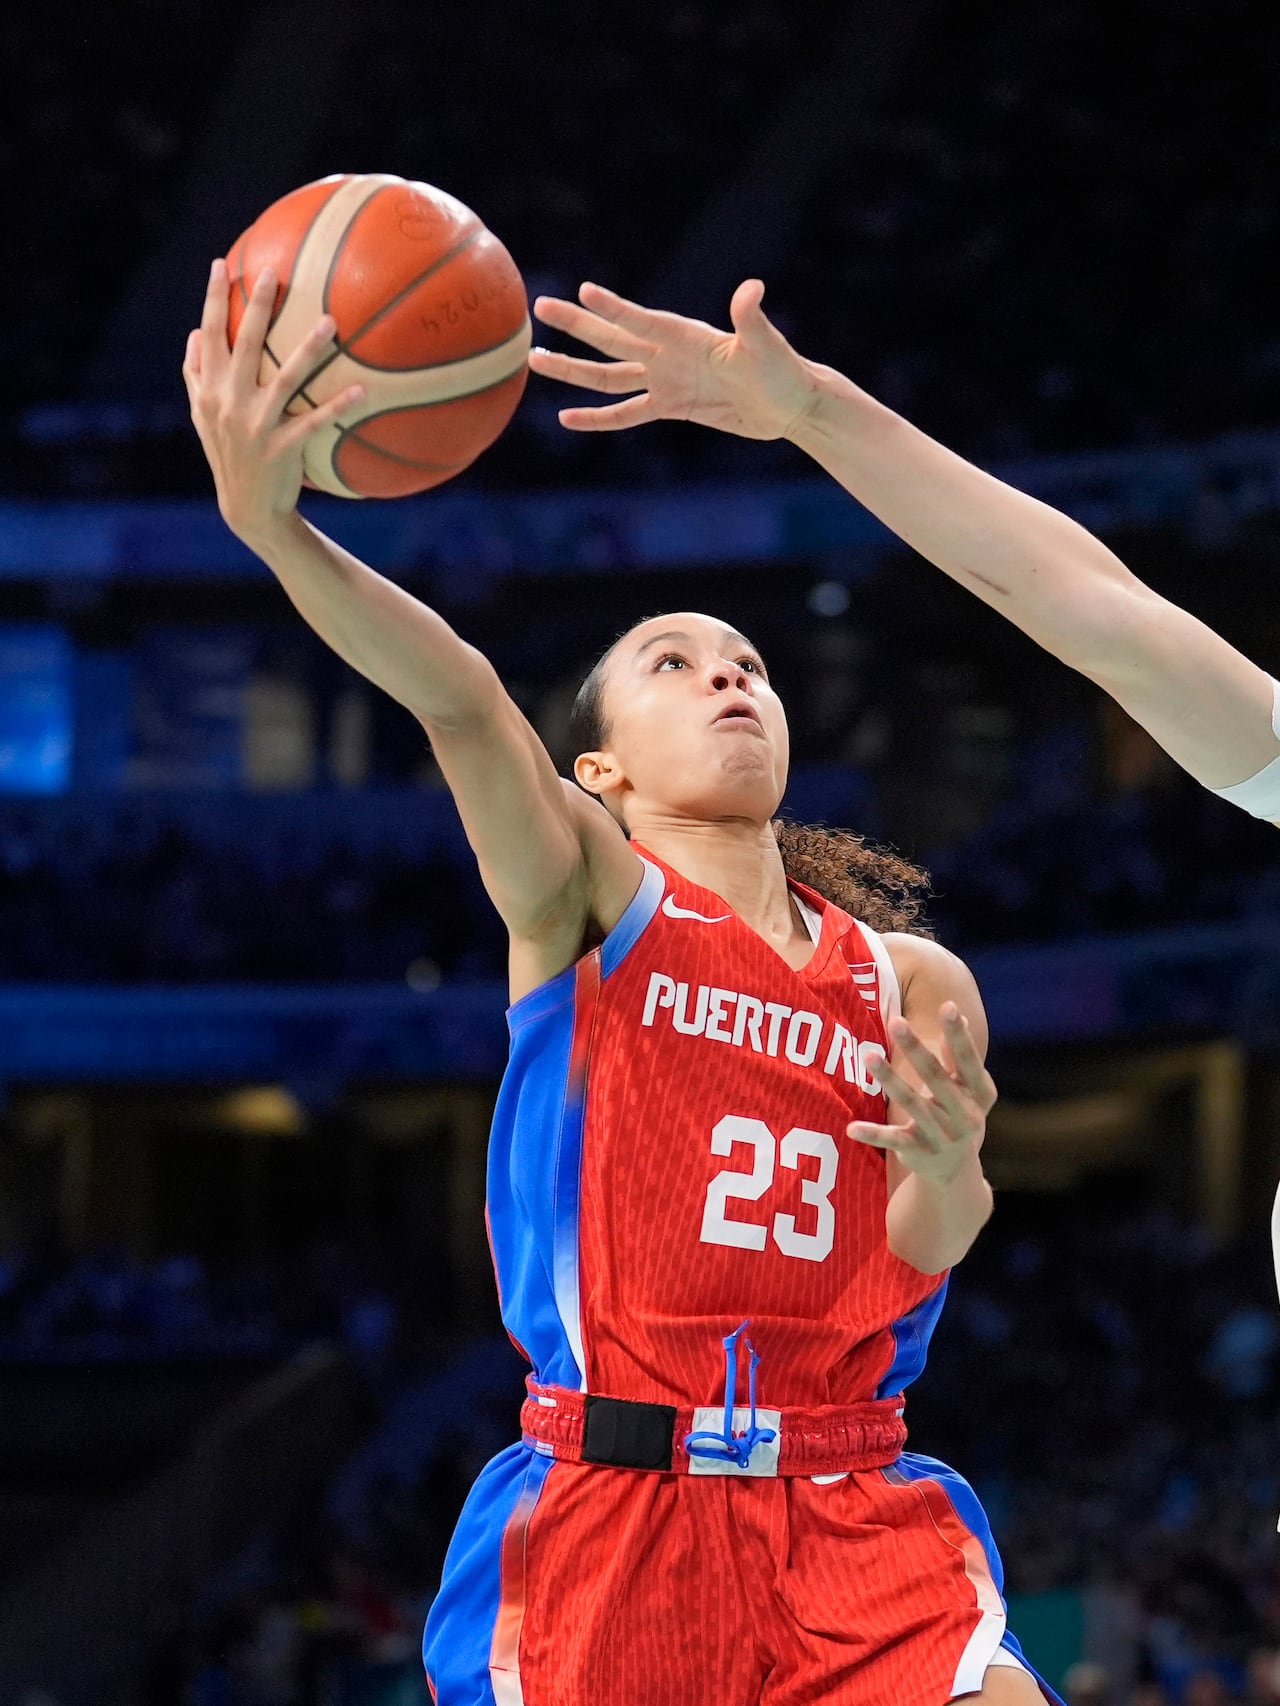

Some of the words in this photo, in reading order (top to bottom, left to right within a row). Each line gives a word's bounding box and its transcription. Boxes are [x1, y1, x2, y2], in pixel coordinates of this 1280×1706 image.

[641, 971, 824, 1068] PUERTO
[823, 1022, 887, 1097] RIC
[699, 1113, 840, 1263] 23
